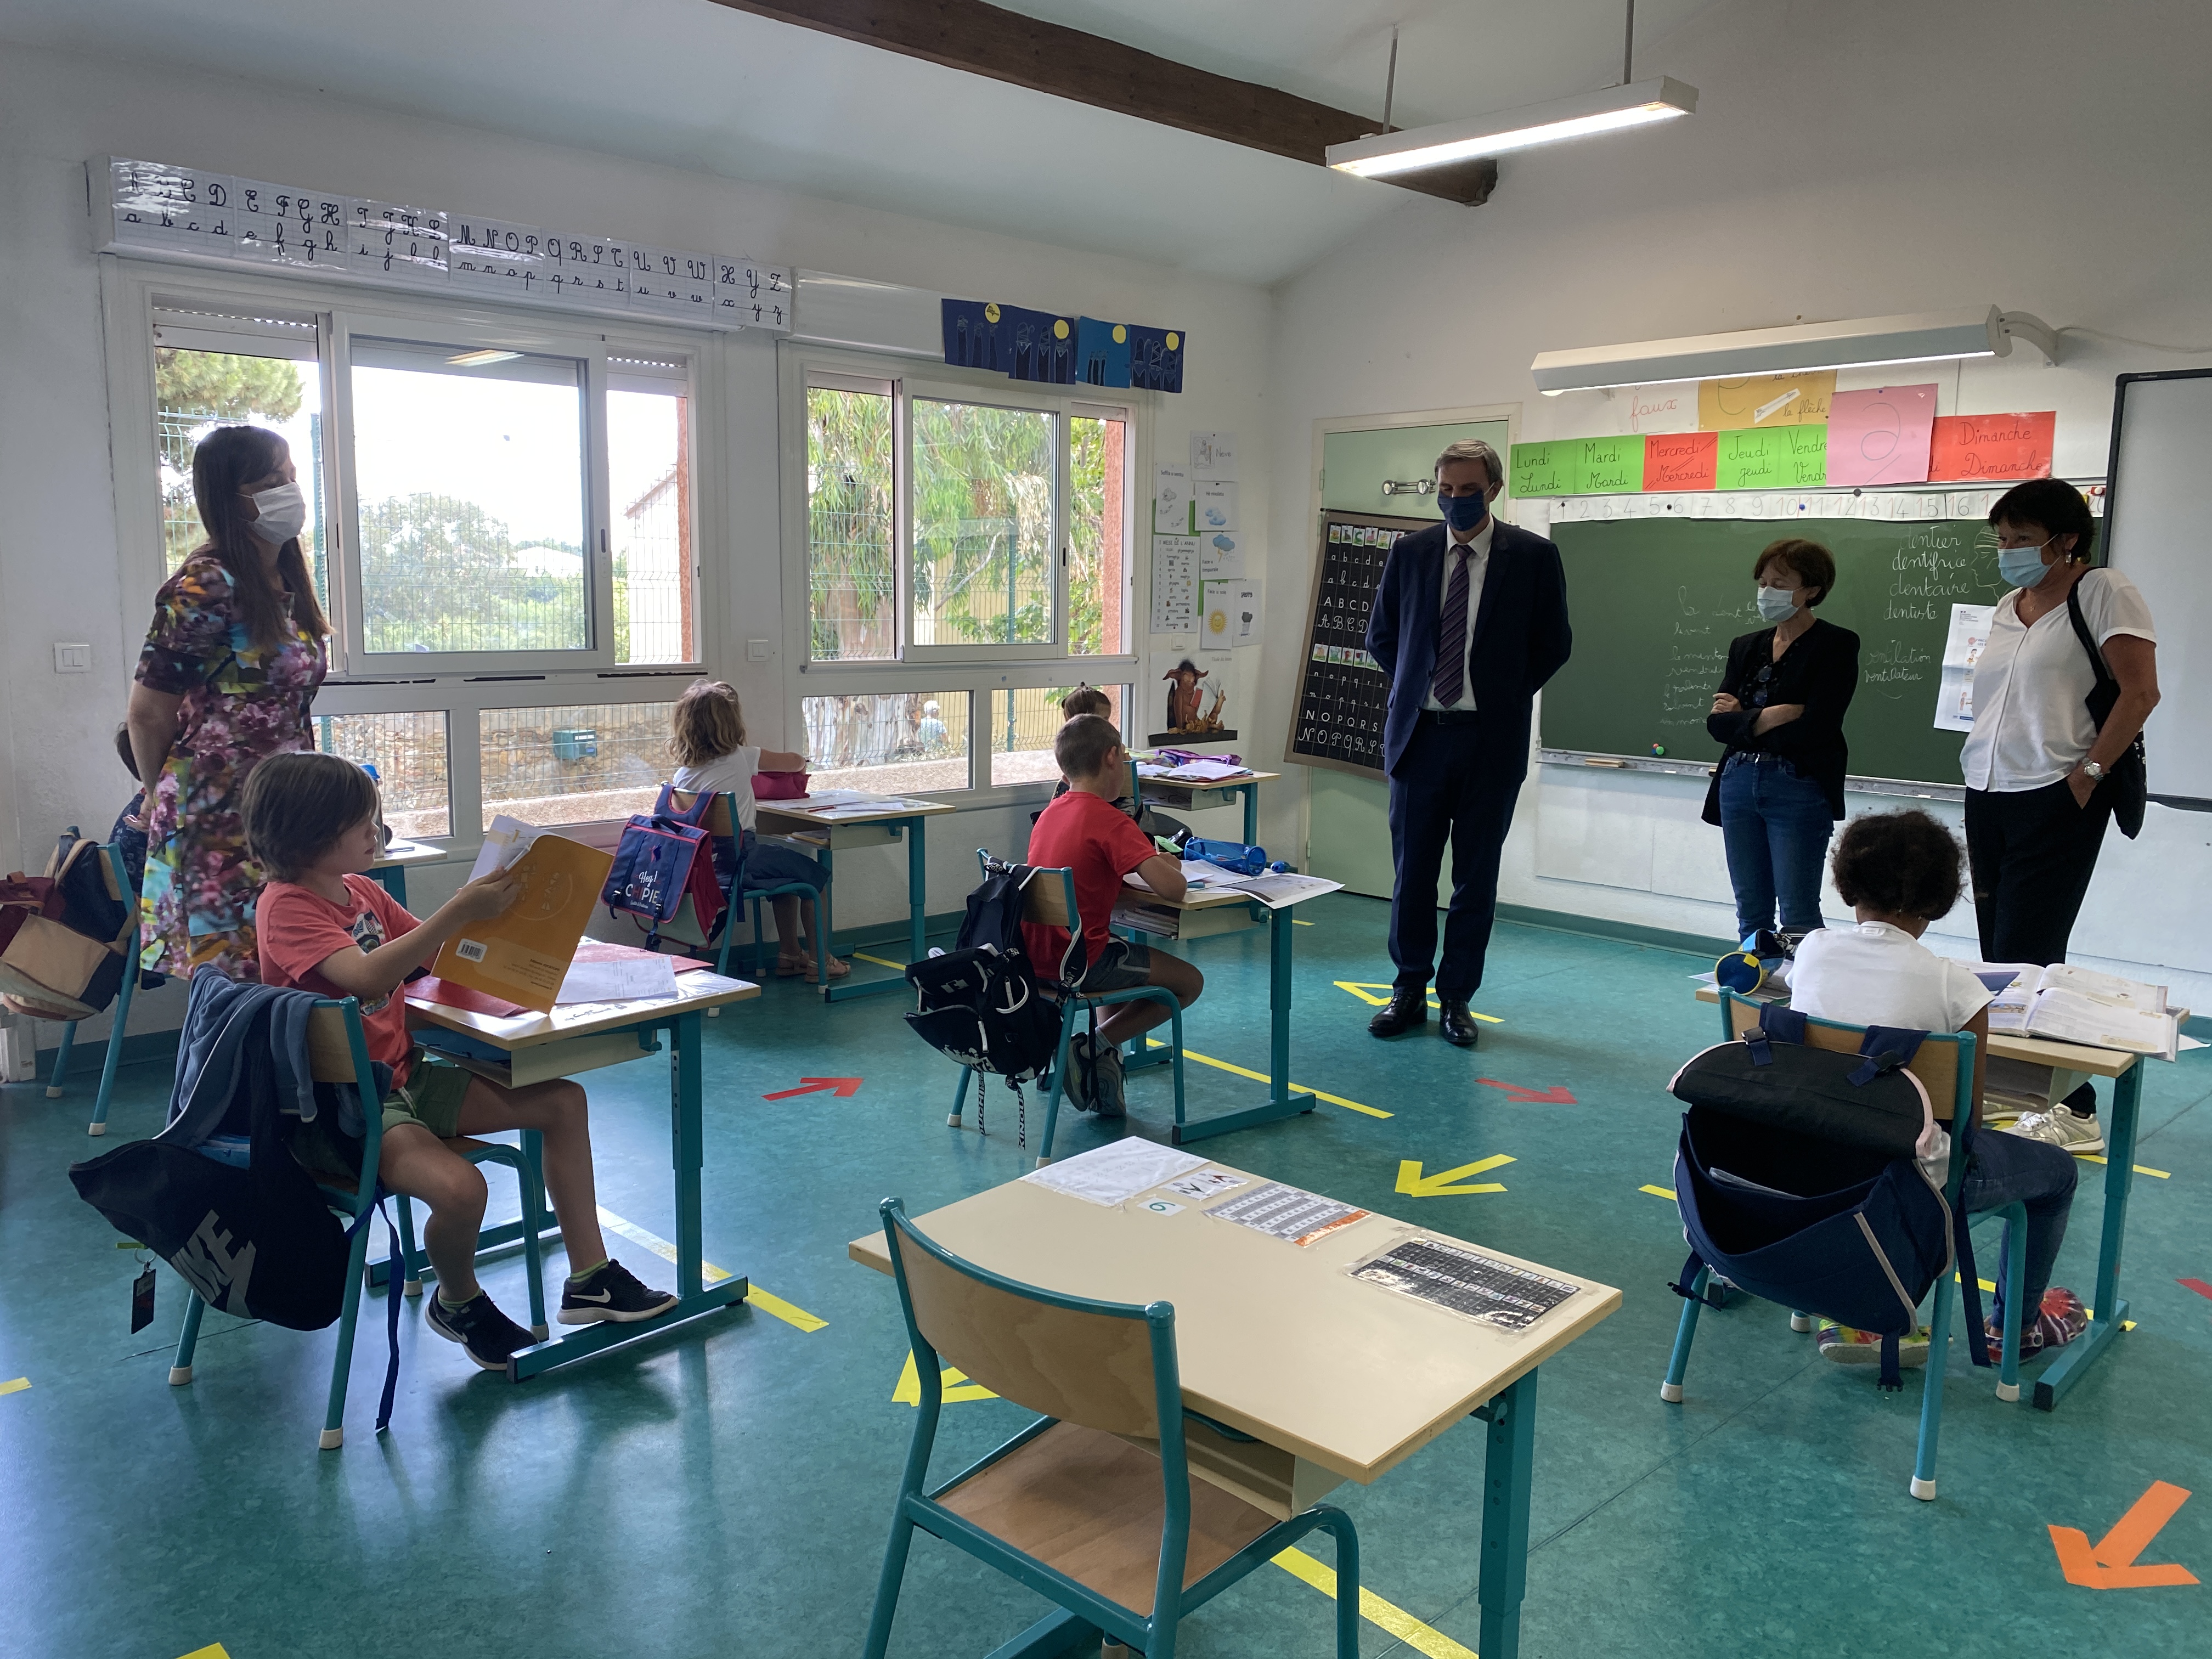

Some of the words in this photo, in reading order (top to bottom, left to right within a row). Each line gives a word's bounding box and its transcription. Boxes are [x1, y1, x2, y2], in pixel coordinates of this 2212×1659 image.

[208, 183, 227, 206] D
[456, 224, 476, 245] M
[483, 228, 498, 249] N
[505, 232, 519, 251] O
[526, 235, 538, 254] P
[569, 242, 587, 262] R
[634, 251, 651, 271] U
[687, 260, 706, 280] W
[124, 213, 141, 223] a
[211, 220, 228, 235] d
[302, 239, 317, 261] g
[324, 230, 337, 251] h
[357, 244, 369, 255] i
[384, 247, 393, 271] j
[458, 262, 476, 271] m
[483, 265, 496, 274] n
[616, 278, 624, 291] t
[637, 286, 650, 295] u
[752, 303, 762, 322] y
[1629, 395, 1678, 433] faux
[1782, 403, 1793, 417] la
[1797, 398, 1827, 422] flèche
[1959, 419, 2032, 445] Dimanche
[1216, 446, 1232, 457] Neve
[1516, 447, 1550, 469] Lundi
[1584, 442, 1622, 464] Mardi
[1650, 438, 1701, 459] Mercredi
[1729, 435, 1771, 460] Jeudi
[1656, 462, 1709, 483] Mercredi
[1960, 450, 2042, 476] Dimanche
[1520, 471, 1561, 493] Lundi
[1586, 470, 1628, 489] Mardi
[1557, 501, 1565, 520] 1
[1579, 500, 1590, 518] 2
[1602, 498, 1612, 518] 3
[1623, 498, 1637, 518] 4
[1650, 496, 1661, 515] 5
[1673, 496, 1684, 514] 6
[1700, 497, 1712, 516] 7
[1725, 496, 1735, 515] 8
[1752, 496, 1763, 516] 9
[1776, 495, 1797, 517] 10
[1833, 495, 1857, 516] 12
[1859, 495, 1880, 517] 13
[1888, 496, 1909, 518] 14
[1916, 496, 1938, 518] 15
[1948, 495, 1970, 517] 16
[1900, 524, 1962, 550] dentier
[1343, 551, 1347, 562] b
[1365, 555, 1371, 565] d
[1892, 549, 1966, 581] dentifrice
[1363, 575, 1370, 588] d
[1889, 572, 1970, 597] dentaire
[1323, 596, 1332, 607] A
[1338, 598, 1344, 608] B
[1349, 600, 1357, 610] C
[1362, 601, 1369, 612] D
[1678, 585, 1700, 616] la
[1712, 592, 1742, 618] dent
[1883, 599, 1938, 620] dentiste
[1318, 614, 1330, 628] A
[1333, 616, 1344, 630] B
[1347, 617, 1355, 631] C
[1358, 619, 1368, 634] D
[1865, 640, 1931, 665] ventilation
[1341, 676, 1346, 686] p
[1306, 709, 1315, 720] N
[1321, 712, 1330, 722] O
[1337, 715, 1343, 724] P
[1347, 717, 1355, 727] Q
[1360, 719, 1366, 730] R
[1372, 722, 1378, 732] S
[1298, 727, 1315, 741] N
[1317, 730, 1327, 744] O
[1331, 732, 1342, 746] P
[1355, 736, 1365, 752] R
[625, 883, 660, 904] CHIPIE
